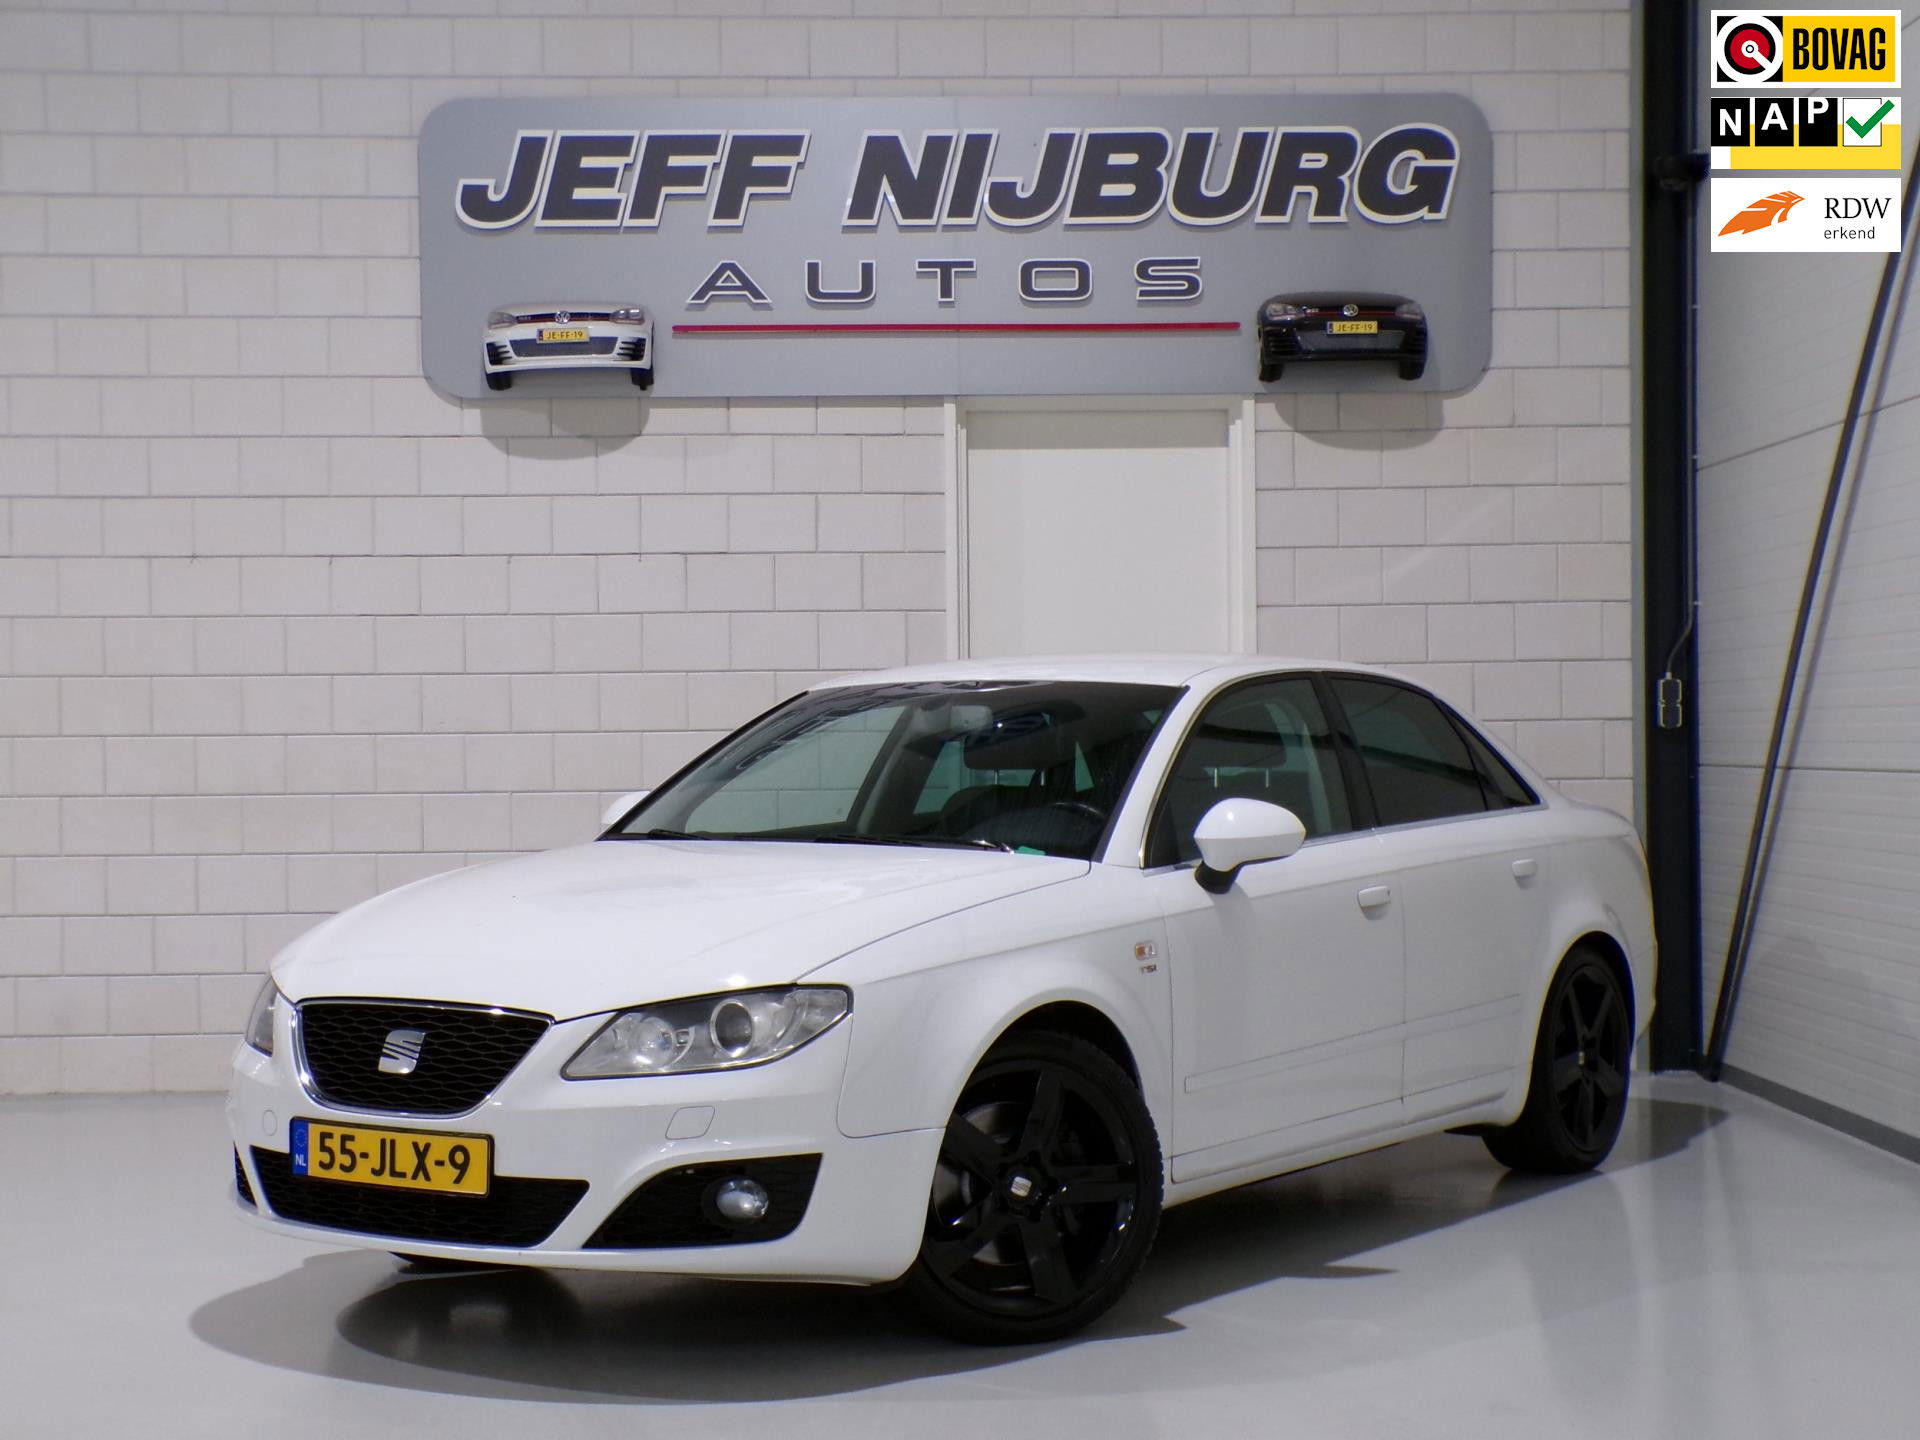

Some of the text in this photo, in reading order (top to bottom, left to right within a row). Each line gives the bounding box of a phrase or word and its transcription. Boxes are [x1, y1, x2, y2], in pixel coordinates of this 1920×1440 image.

[455, 122, 1461, 229] JEFF NIJBURG
[685, 256, 1203, 303] AUTOS
[295, 1154, 307, 1167] NL
[318, 1131, 471, 1185] 55-JLX-9
